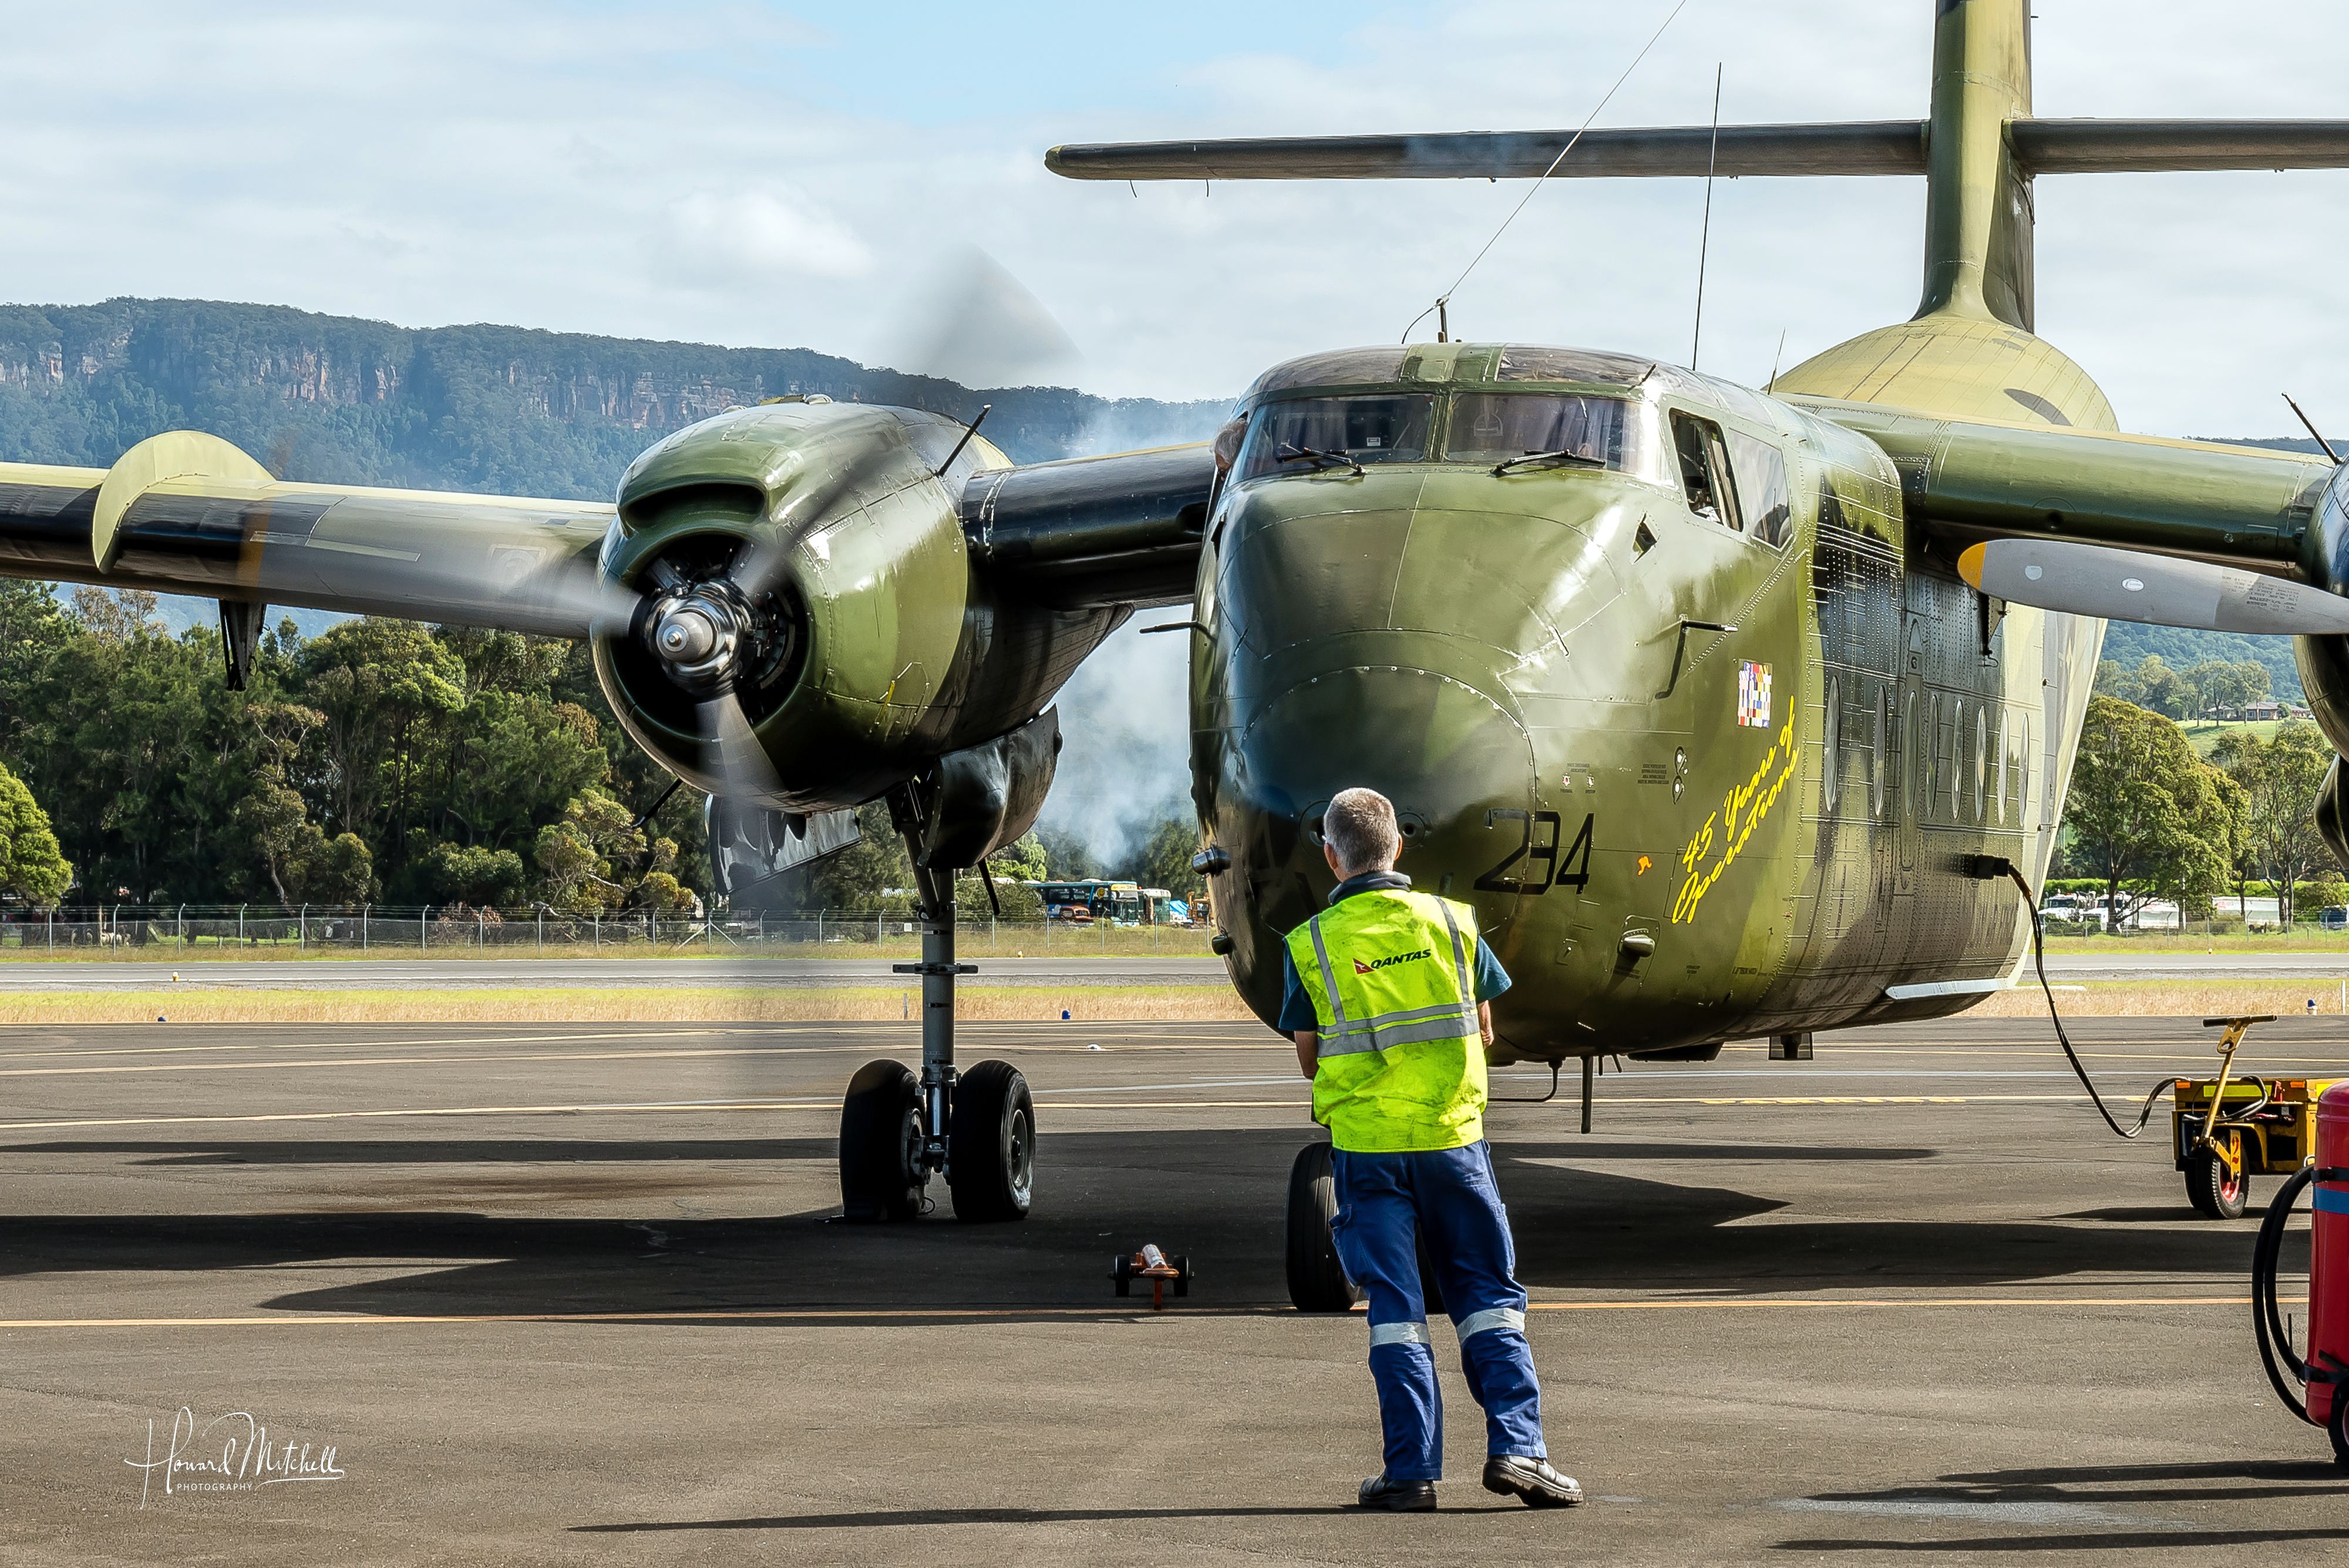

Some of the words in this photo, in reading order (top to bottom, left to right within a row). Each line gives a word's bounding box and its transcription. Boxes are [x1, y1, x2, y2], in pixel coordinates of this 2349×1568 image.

[1672, 746, 1800, 924] Operations
[1682, 811, 1717, 873] 45
[1723, 745, 1777, 842] Years
[1779, 695, 1795, 758] of
[1473, 807, 1595, 895] 234
[1370, 948, 1431, 969] QANTAS
